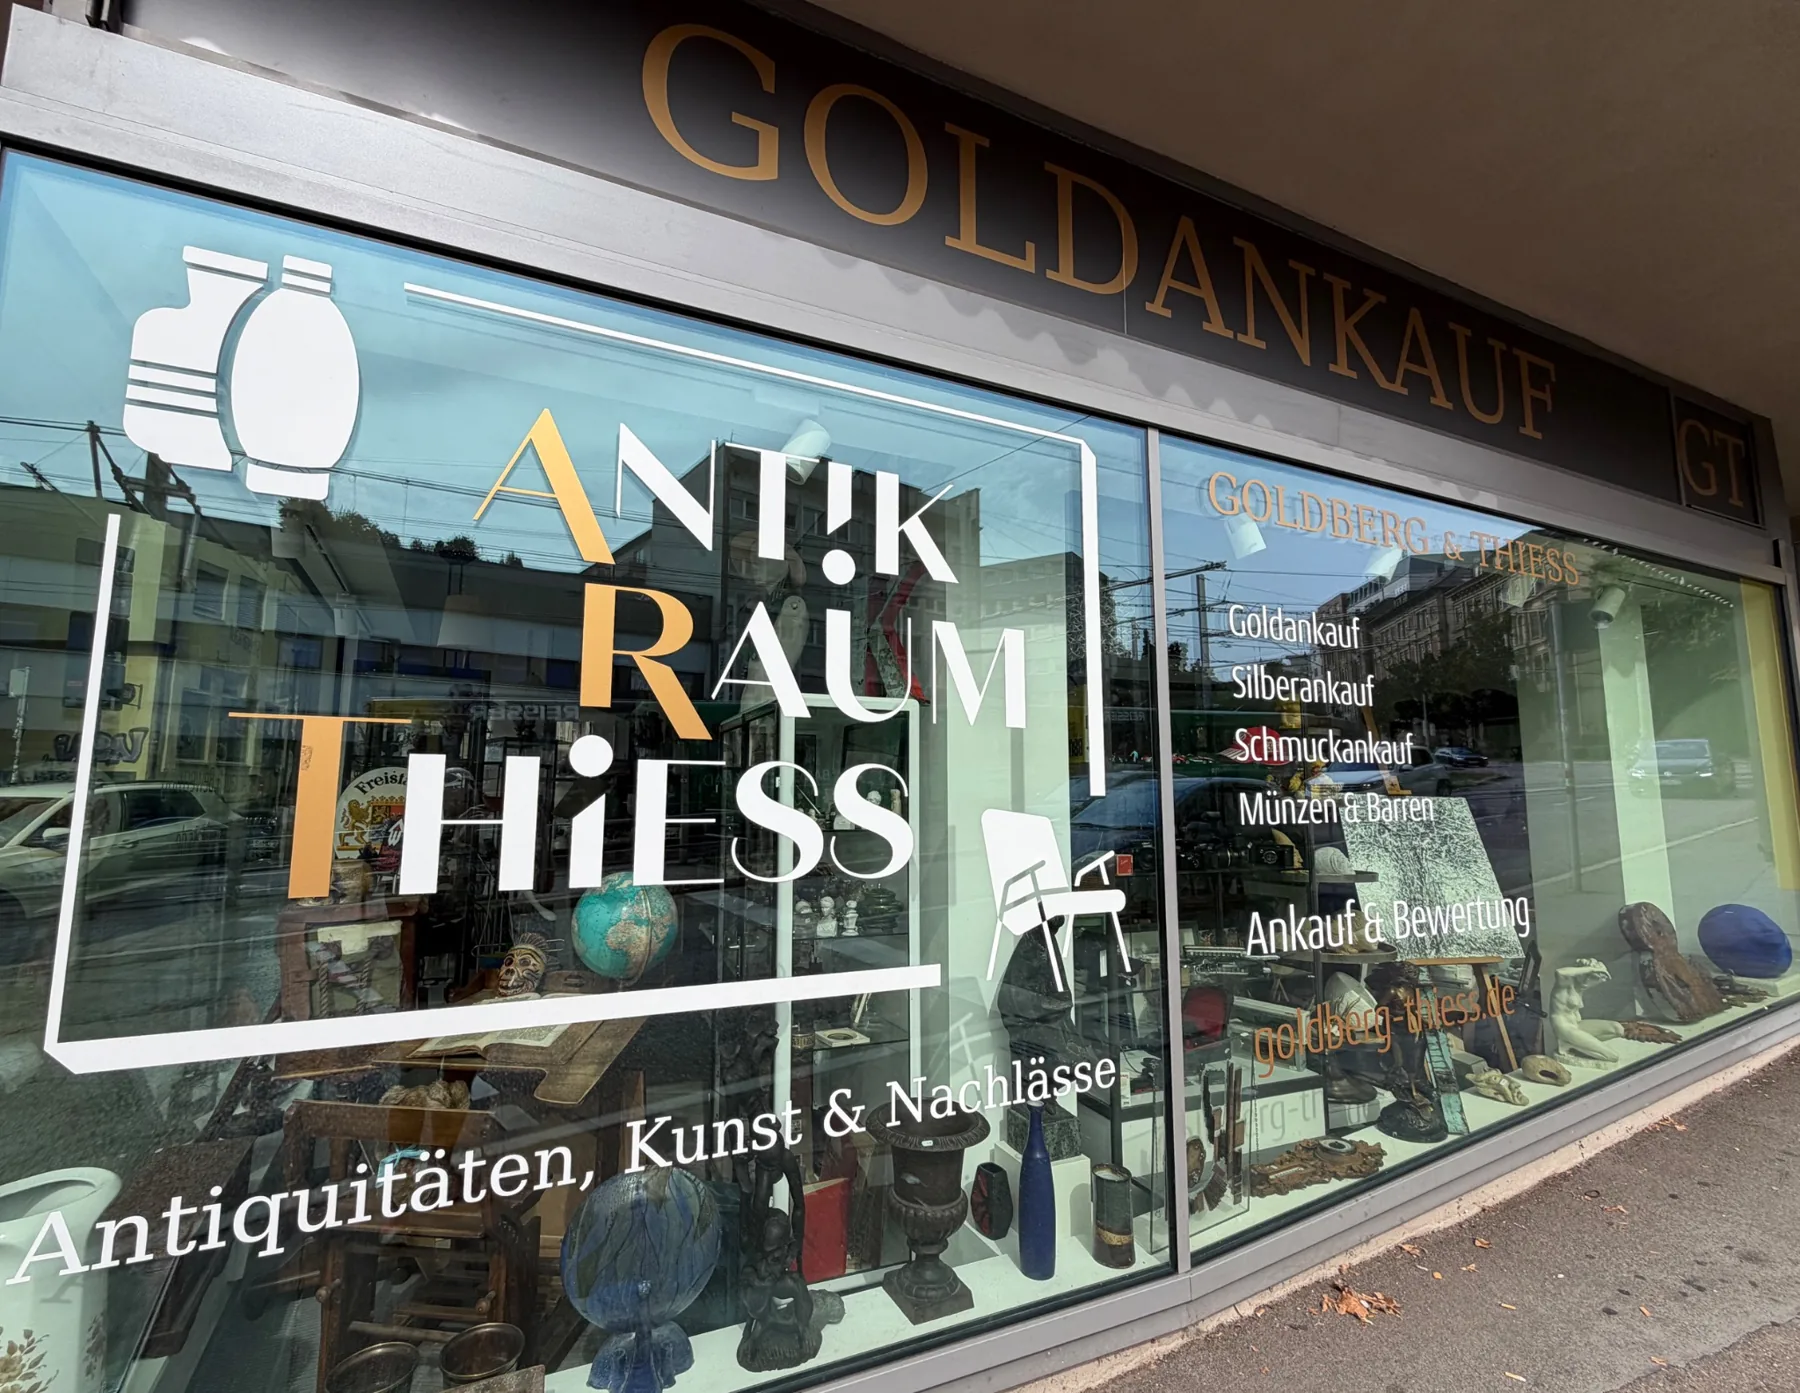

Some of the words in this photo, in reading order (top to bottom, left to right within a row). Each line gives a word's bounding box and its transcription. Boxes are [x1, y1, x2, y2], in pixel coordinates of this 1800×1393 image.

[642, 23, 1556, 439] GOLDANKAUF
[1677, 419, 1745, 507] GT
[1208, 471, 1430, 555] GOLDBERG
[1443, 530, 1464, 561] &
[1470, 531, 1580, 586] THIESS
[579, 583, 1027, 741] RAUM
[1229, 604, 1360, 649] Goldankauf
[1232, 665, 1374, 707] Silberankauf
[1235, 726, 1413, 765] Schmuckankauf
[1239, 790, 1338, 826] Münzen
[1344, 792, 1362, 823] &
[1366, 792, 1434, 823] Barren
[1246, 899, 1356, 956] Ankauf
[1364, 902, 1386, 944] &
[1393, 896, 1530, 938] Bewertung
[1254, 975, 1516, 1079] goldberg-thiess.de
[5, 1145, 595, 1286] Antiquitäten,
[625, 1099, 803, 1174] Kunst
[823, 1088, 867, 1138] &
[886, 1056, 1116, 1127] Nachlässe
